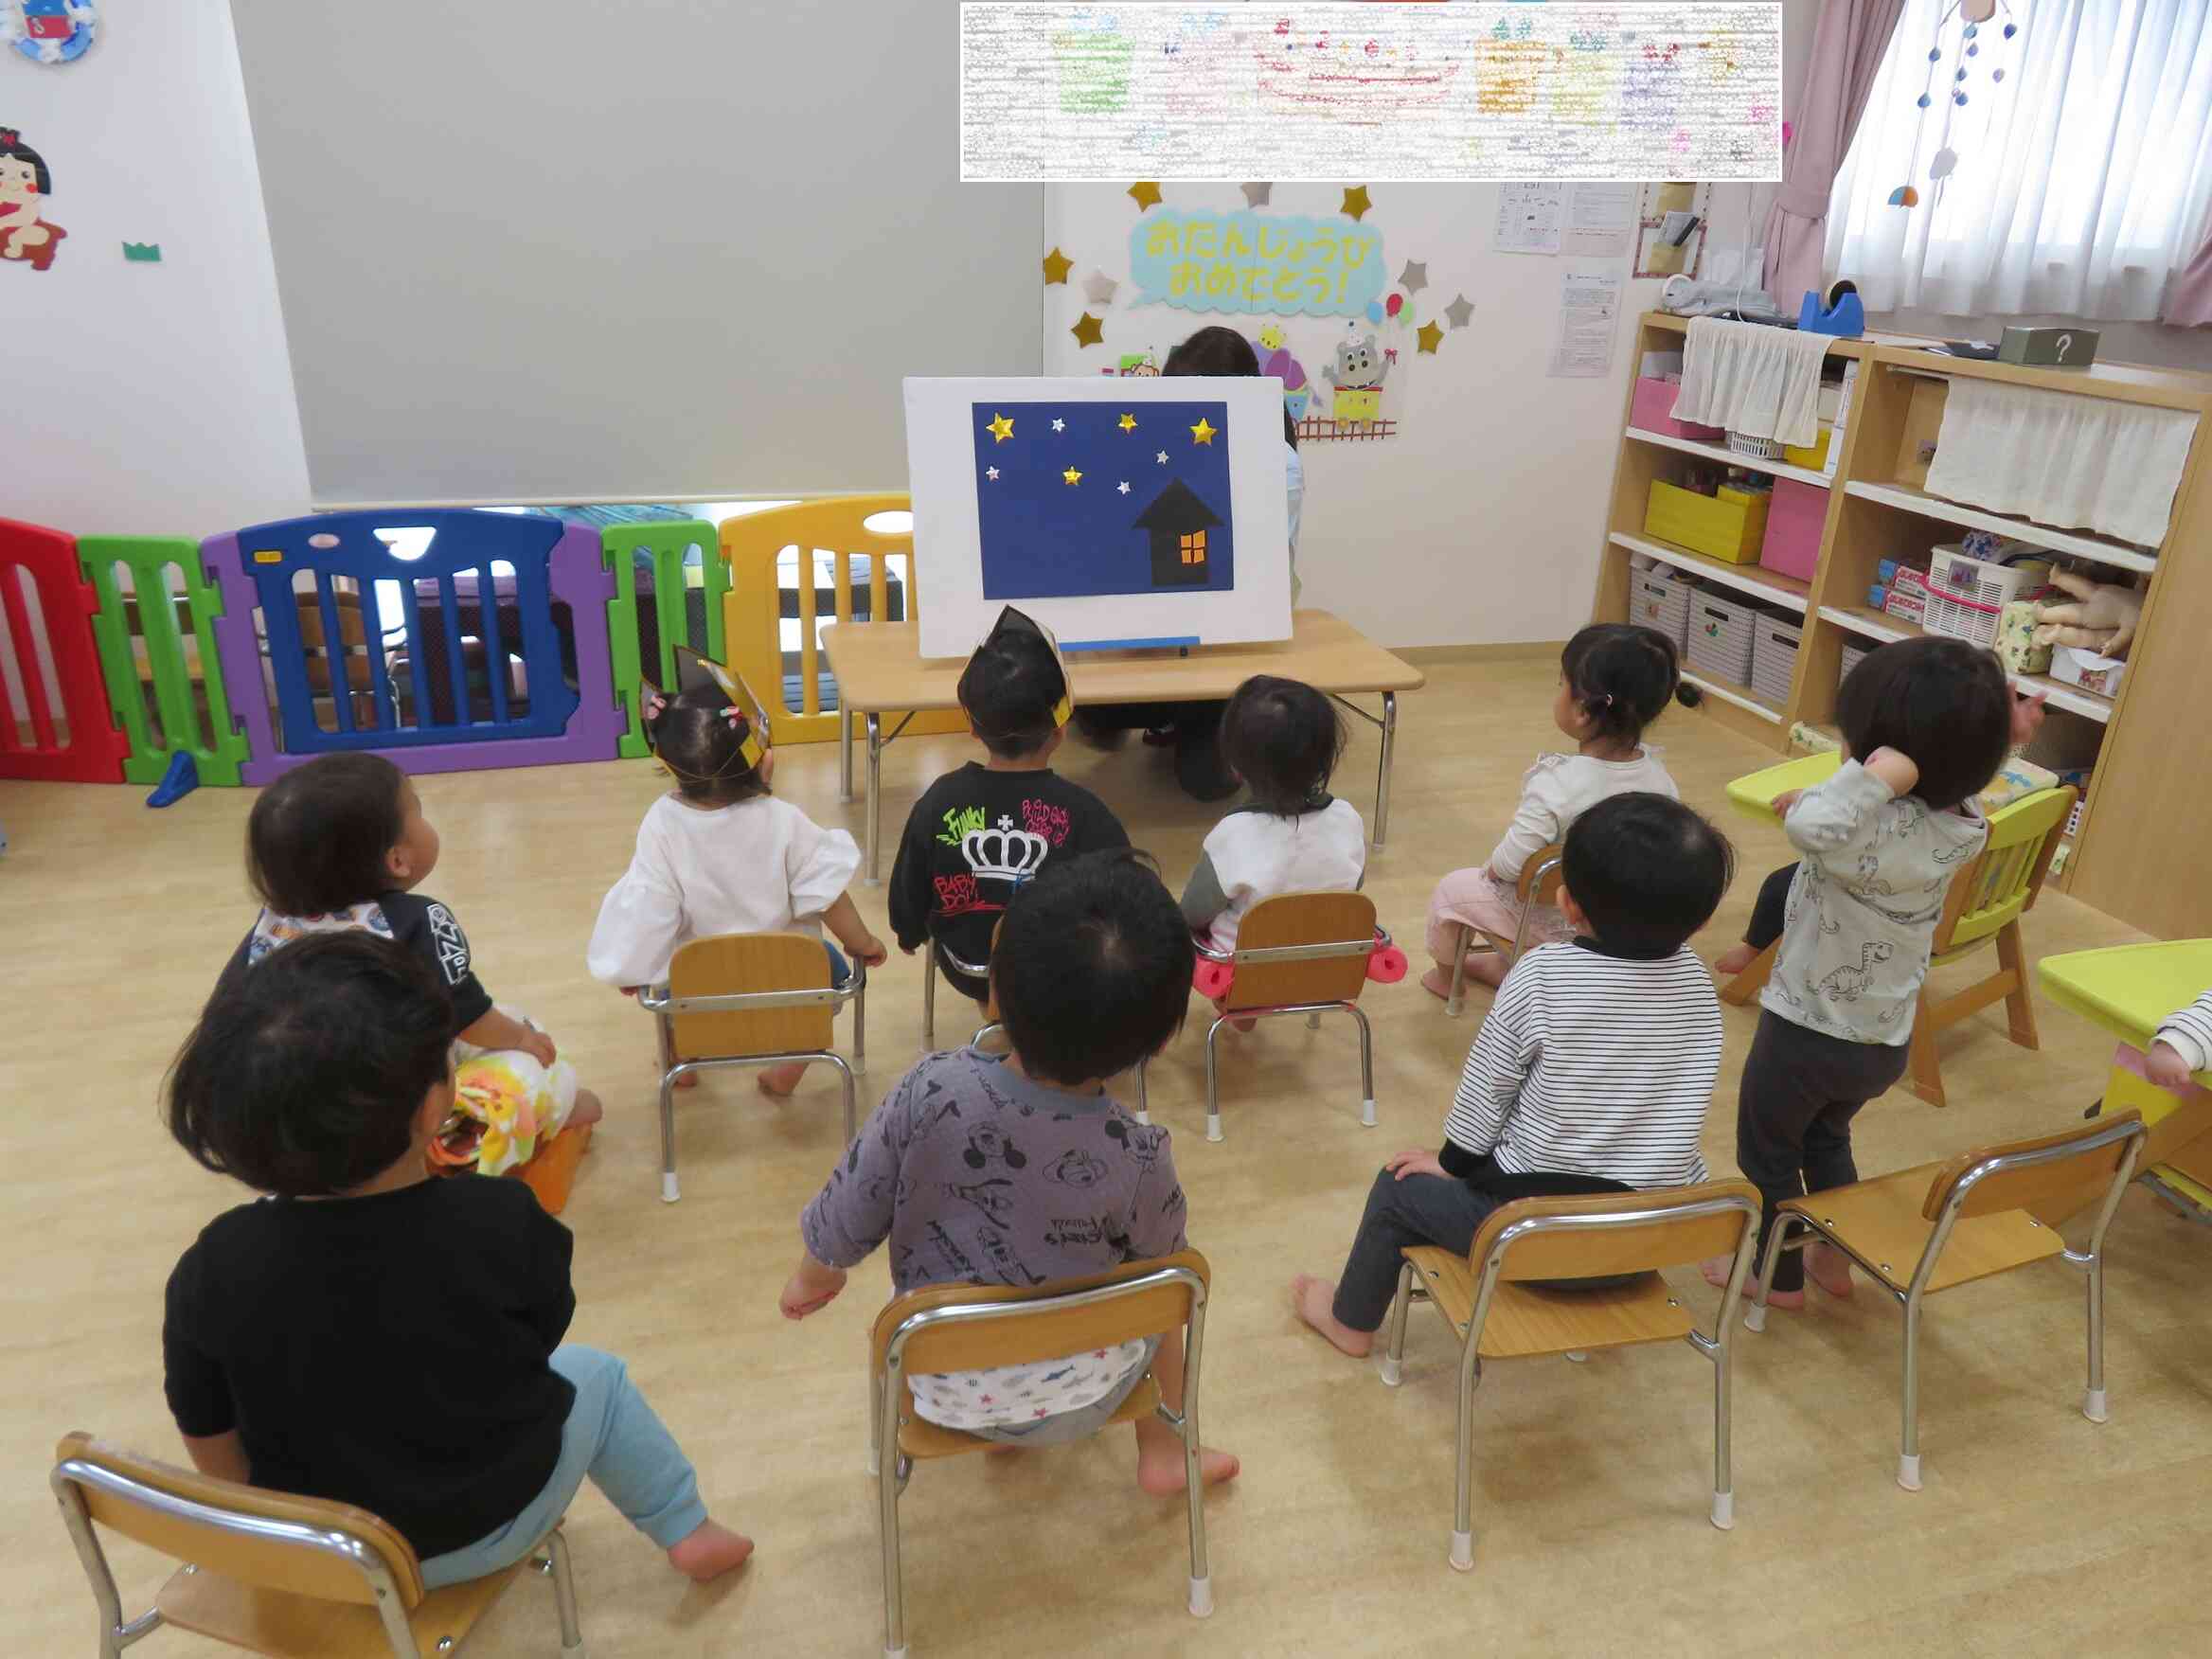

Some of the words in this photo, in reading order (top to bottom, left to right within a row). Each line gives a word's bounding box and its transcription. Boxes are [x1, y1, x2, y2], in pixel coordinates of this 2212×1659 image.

[1146, 220, 1376, 270] おたんじょうび
[2056, 333, 2072, 363] ?
[934, 873, 975, 895] BABY
